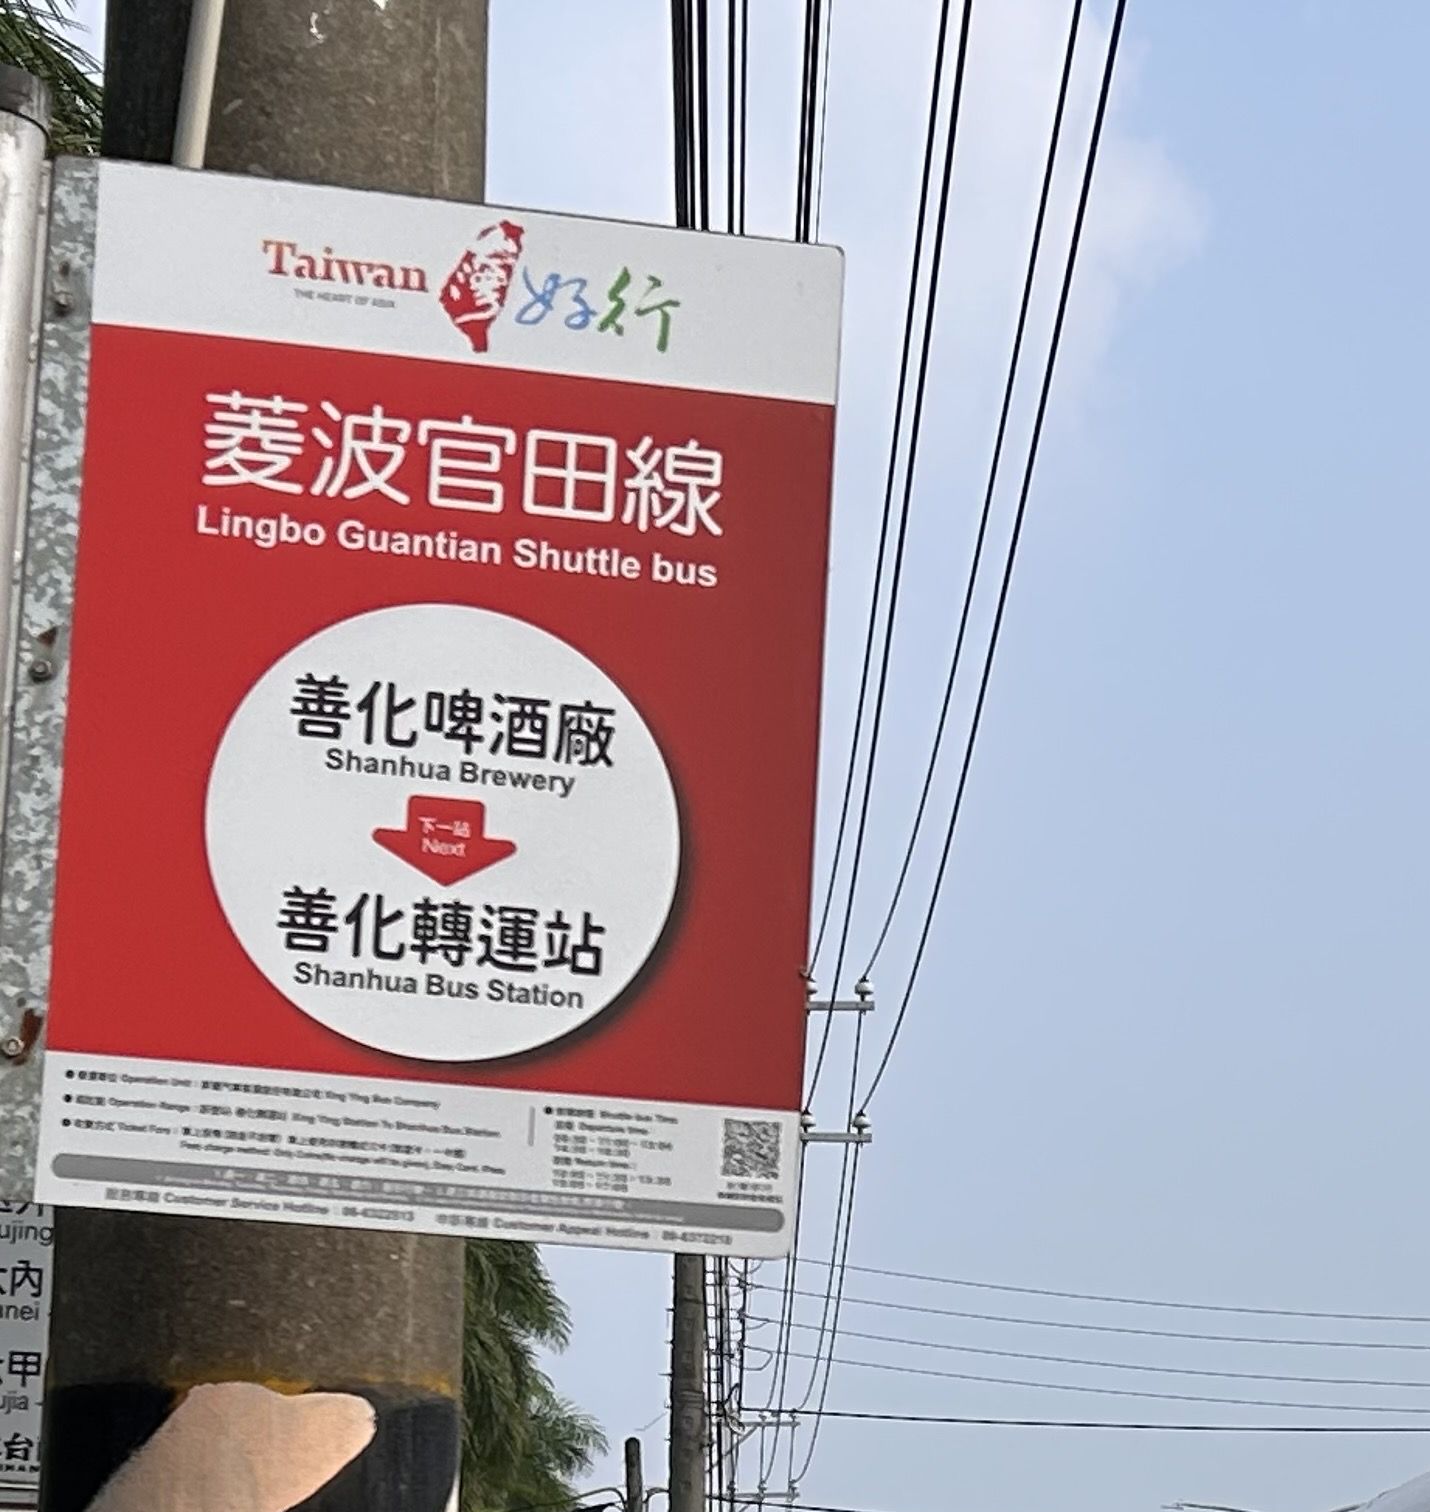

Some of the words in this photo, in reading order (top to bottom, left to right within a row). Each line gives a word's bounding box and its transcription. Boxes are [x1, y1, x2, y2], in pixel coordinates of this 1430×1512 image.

[263, 239, 428, 293] Taiwan
[515, 266, 680, 353] 好行
[201, 390, 723, 538] 菱波官田線
[197, 506, 326, 549] Lingbo
[337, 519, 502, 566] Guantian
[514, 538, 642, 581] Shuttle
[652, 554, 718, 587] bus
[290, 673, 616, 768] 善化啤酒廠
[325, 747, 451, 782] Shanhua
[459, 761, 576, 798] Brewery
[419, 816, 471, 838] 下一站
[421, 837, 467, 857] Next
[276, 885, 606, 976] 善化轉運站
[294, 961, 418, 995] Shanhua
[425, 973, 479, 1000] Bus
[486, 979, 584, 1009] Station
[0, 1259, 43, 1298] 內
[0, 1351, 41, 1388] 甲
